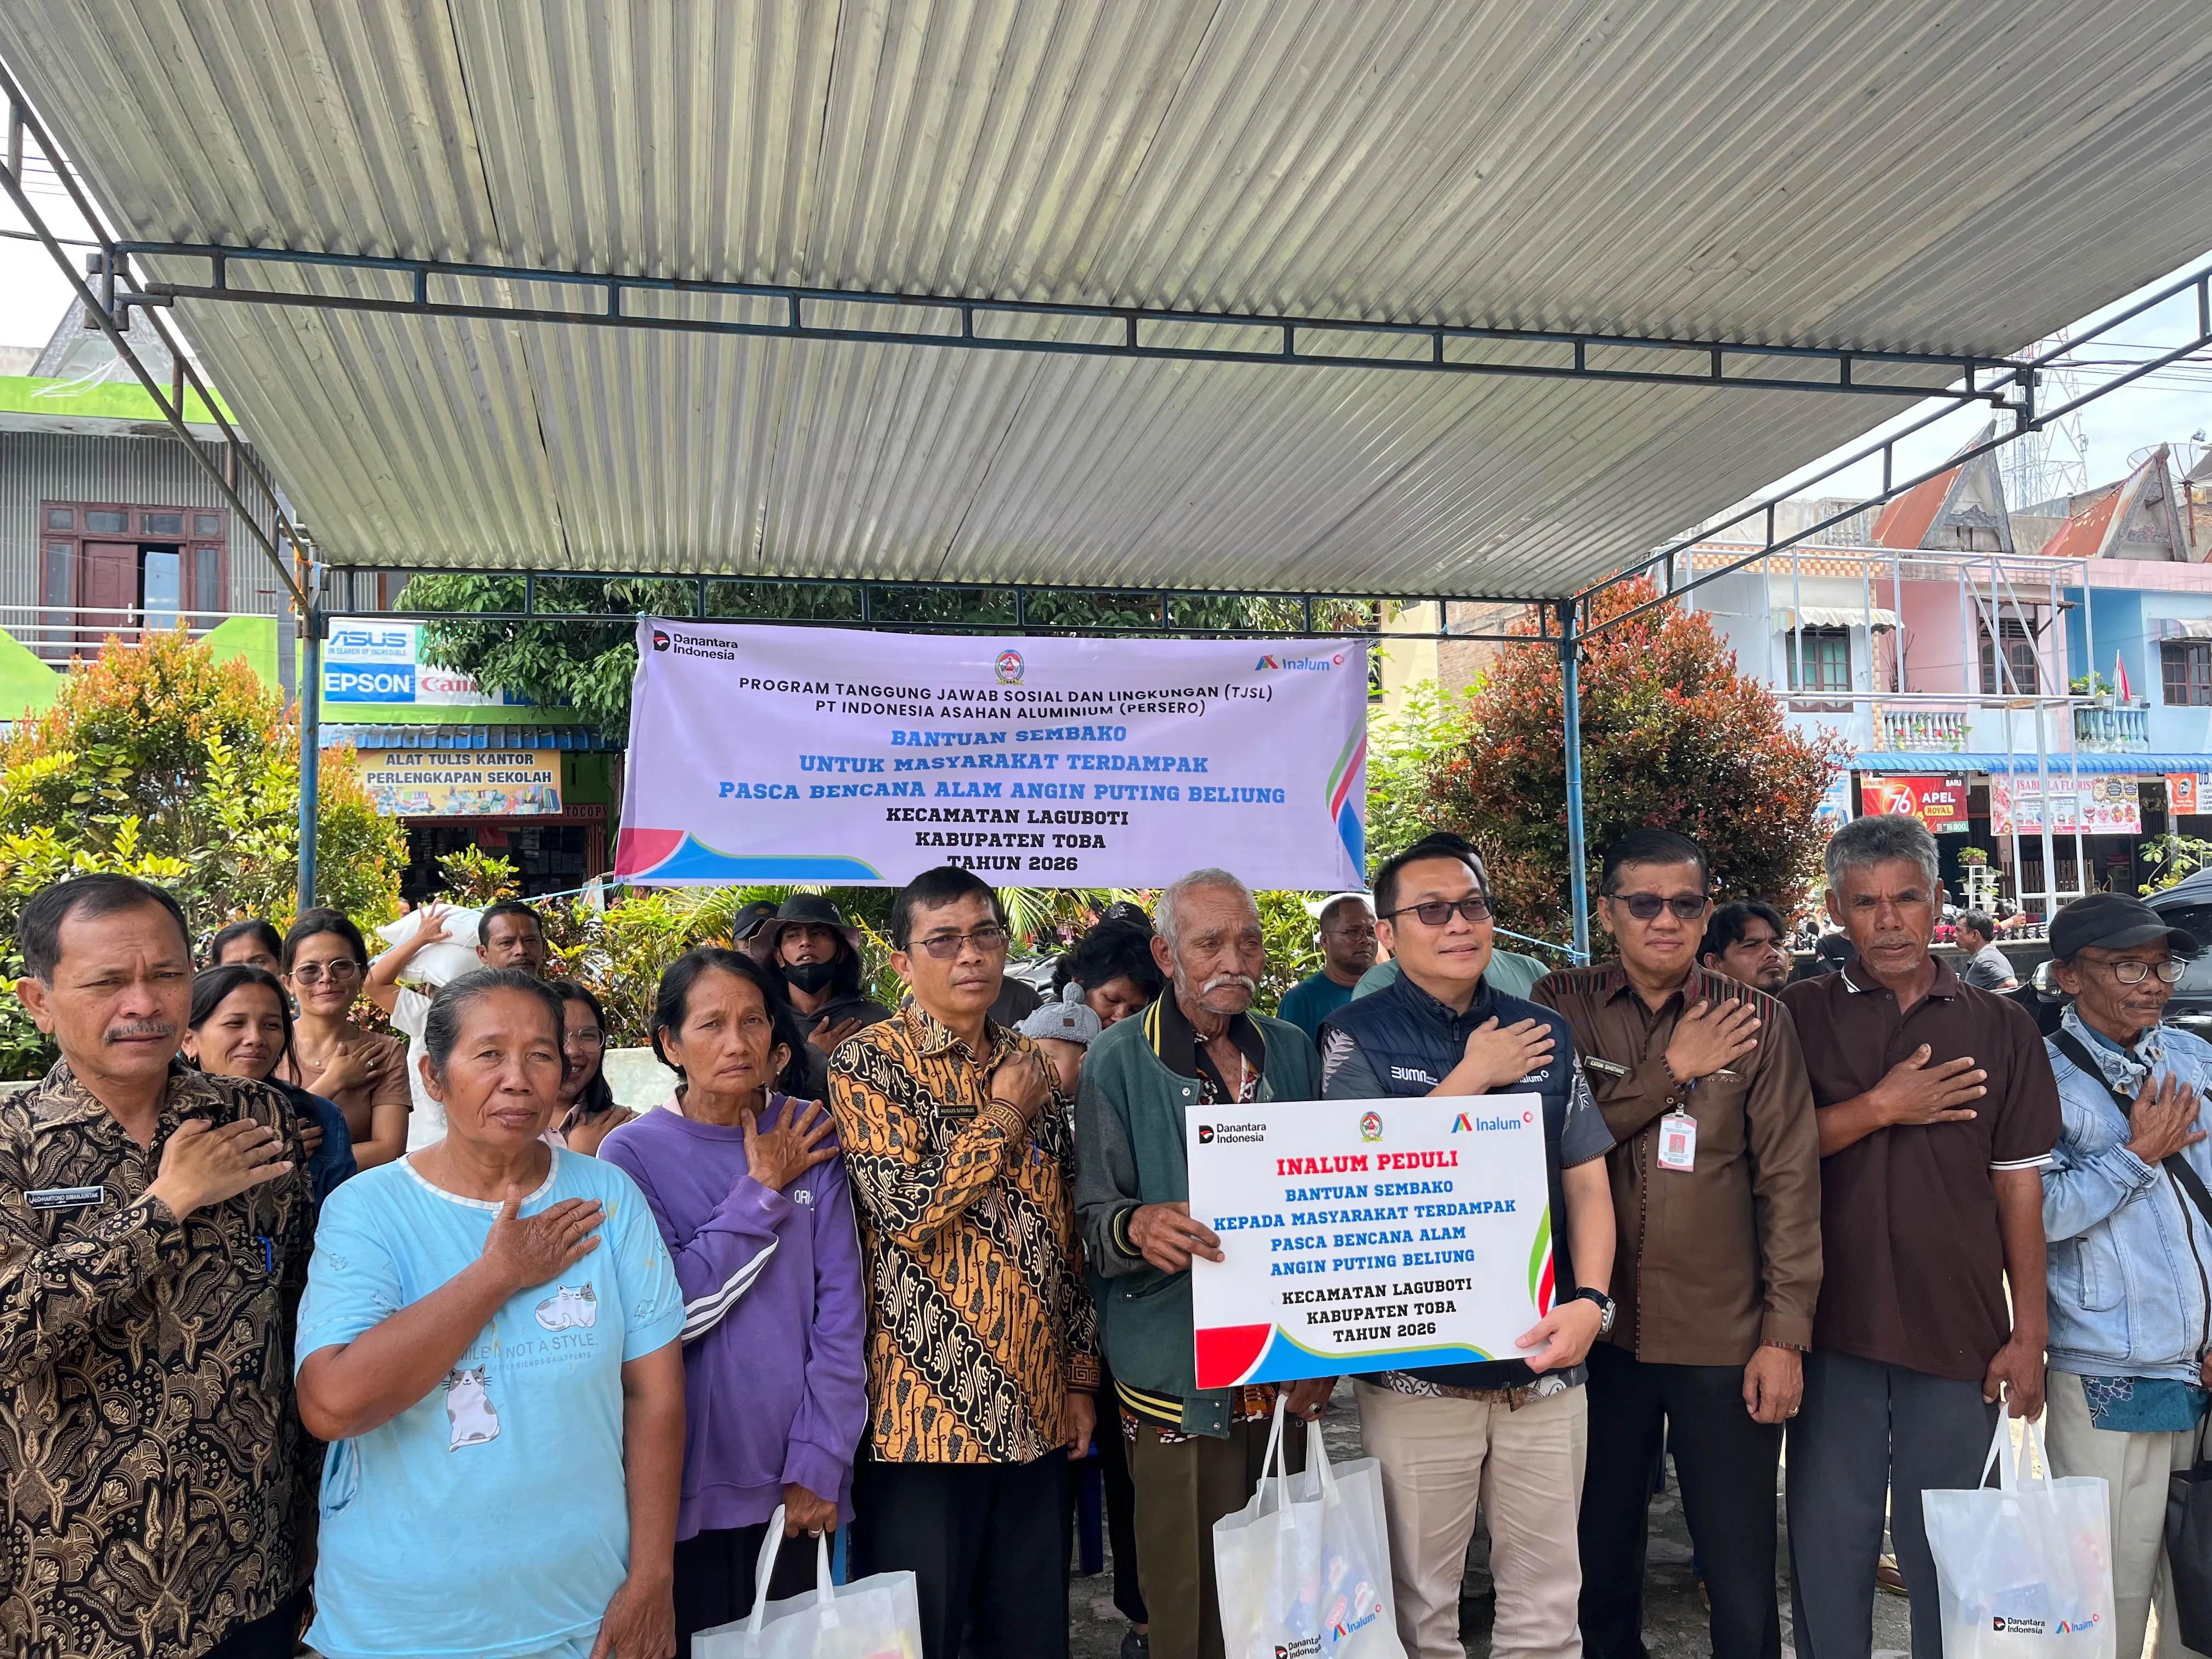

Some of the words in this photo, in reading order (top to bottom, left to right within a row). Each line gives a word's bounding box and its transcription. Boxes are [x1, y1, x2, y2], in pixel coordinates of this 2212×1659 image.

[329, 631, 407, 647] ASUS
[673, 633, 739, 649] Danantara
[673, 642, 735, 661] Indonesia
[1283, 657, 1329, 670] Inalum
[325, 673, 410, 693] EPSON
[421, 676, 477, 692] Can
[740, 678, 828, 694] PROGRAM
[836, 684, 930, 699] TANGGUNG
[937, 689, 997, 701] JAWAB
[1005, 691, 1063, 702] SOSIAL
[1069, 691, 1103, 702] DAN
[1109, 687, 1218, 701] LINGKUNGAN
[1225, 684, 1272, 702] (TJSL)
[816, 700, 836, 712] PT
[843, 702, 934, 717] INDONESIA
[940, 707, 1011, 718] ASAHAN
[1017, 706, 1113, 718] ALUMINIUM
[1120, 700, 1205, 716] (PERSERO)
[891, 731, 1006, 747] BANTUAN
[1015, 726, 1126, 741] SEMBAKO
[386, 754, 424, 766] ALAT
[428, 753, 471, 765] TULIS
[476, 753, 534, 765] KANTOR
[800, 755, 884, 772] UNTUK
[894, 754, 1058, 771] MASYARAKAT
[1066, 755, 1207, 772] TERDAMPAK
[367, 771, 482, 783] PERLENGKAPAN
[487, 771, 551, 783] SEKOLAH
[1946, 779, 1962, 787] BARU
[719, 782, 799, 799] PASCA
[810, 782, 926, 798] BENCANA
[935, 782, 1001, 797] ALAM
[1011, 783, 1085, 799] ANGIN
[1094, 785, 1179, 801] PUTING
[1189, 787, 1284, 803] BELIUNG
[1889, 786, 1911, 814] 76
[1922, 792, 1956, 803] APEL
[886, 808, 1019, 823] KECAMATAN
[1028, 810, 1128, 825] LAGUBOTI
[916, 832, 1045, 847] KABUPATEN
[1052, 834, 1105, 848] TOBA
[947, 855, 1022, 871] TAHUN
[1029, 856, 1077, 871] 2026
[1391, 1066, 1427, 1083] BUMN
[1514, 1074, 1543, 1084] nalum
[1217, 1123, 1266, 1132] Danantara
[1476, 1117, 1520, 1131] Inalum
[1217, 1132, 1263, 1143] Indonesia
[1277, 1155, 1368, 1176] INALUM
[1377, 1150, 1458, 1170] PEDULI
[1285, 1185, 1368, 1201] BANTUAN
[1374, 1181, 1453, 1196] SEMBAKO
[1214, 1214, 1285, 1231] KEPADA
[1291, 1206, 1408, 1226] MASYARAKAT
[1414, 1200, 1516, 1217] TERDAMPAK
[1271, 1235, 1327, 1251] PASCA
[1333, 1230, 1413, 1247] BENCANA
[1420, 1227, 1466, 1241] ALAM
[1271, 1260, 1326, 1276] ANGIN
[1333, 1255, 1396, 1271] PUTING
[1402, 1249, 1474, 1266] BELIUNG
[1282, 1284, 1386, 1305] KECAMATAN
[1392, 1278, 1472, 1295] LAGUBOTI
[1307, 1304, 1408, 1324] KABUPATEN
[1414, 1300, 1457, 1315] TOBA
[1333, 1325, 1391, 1342] TAHUN
[1397, 1322, 1436, 1337] 2026
[506, 1341, 534, 1359] NOT
[539, 1339, 549, 1353] A
[1347, 1613, 1375, 1633] Inalum
[2007, 1617, 2046, 1627] Danantara
[2007, 1626, 2043, 1634] Indonesia
